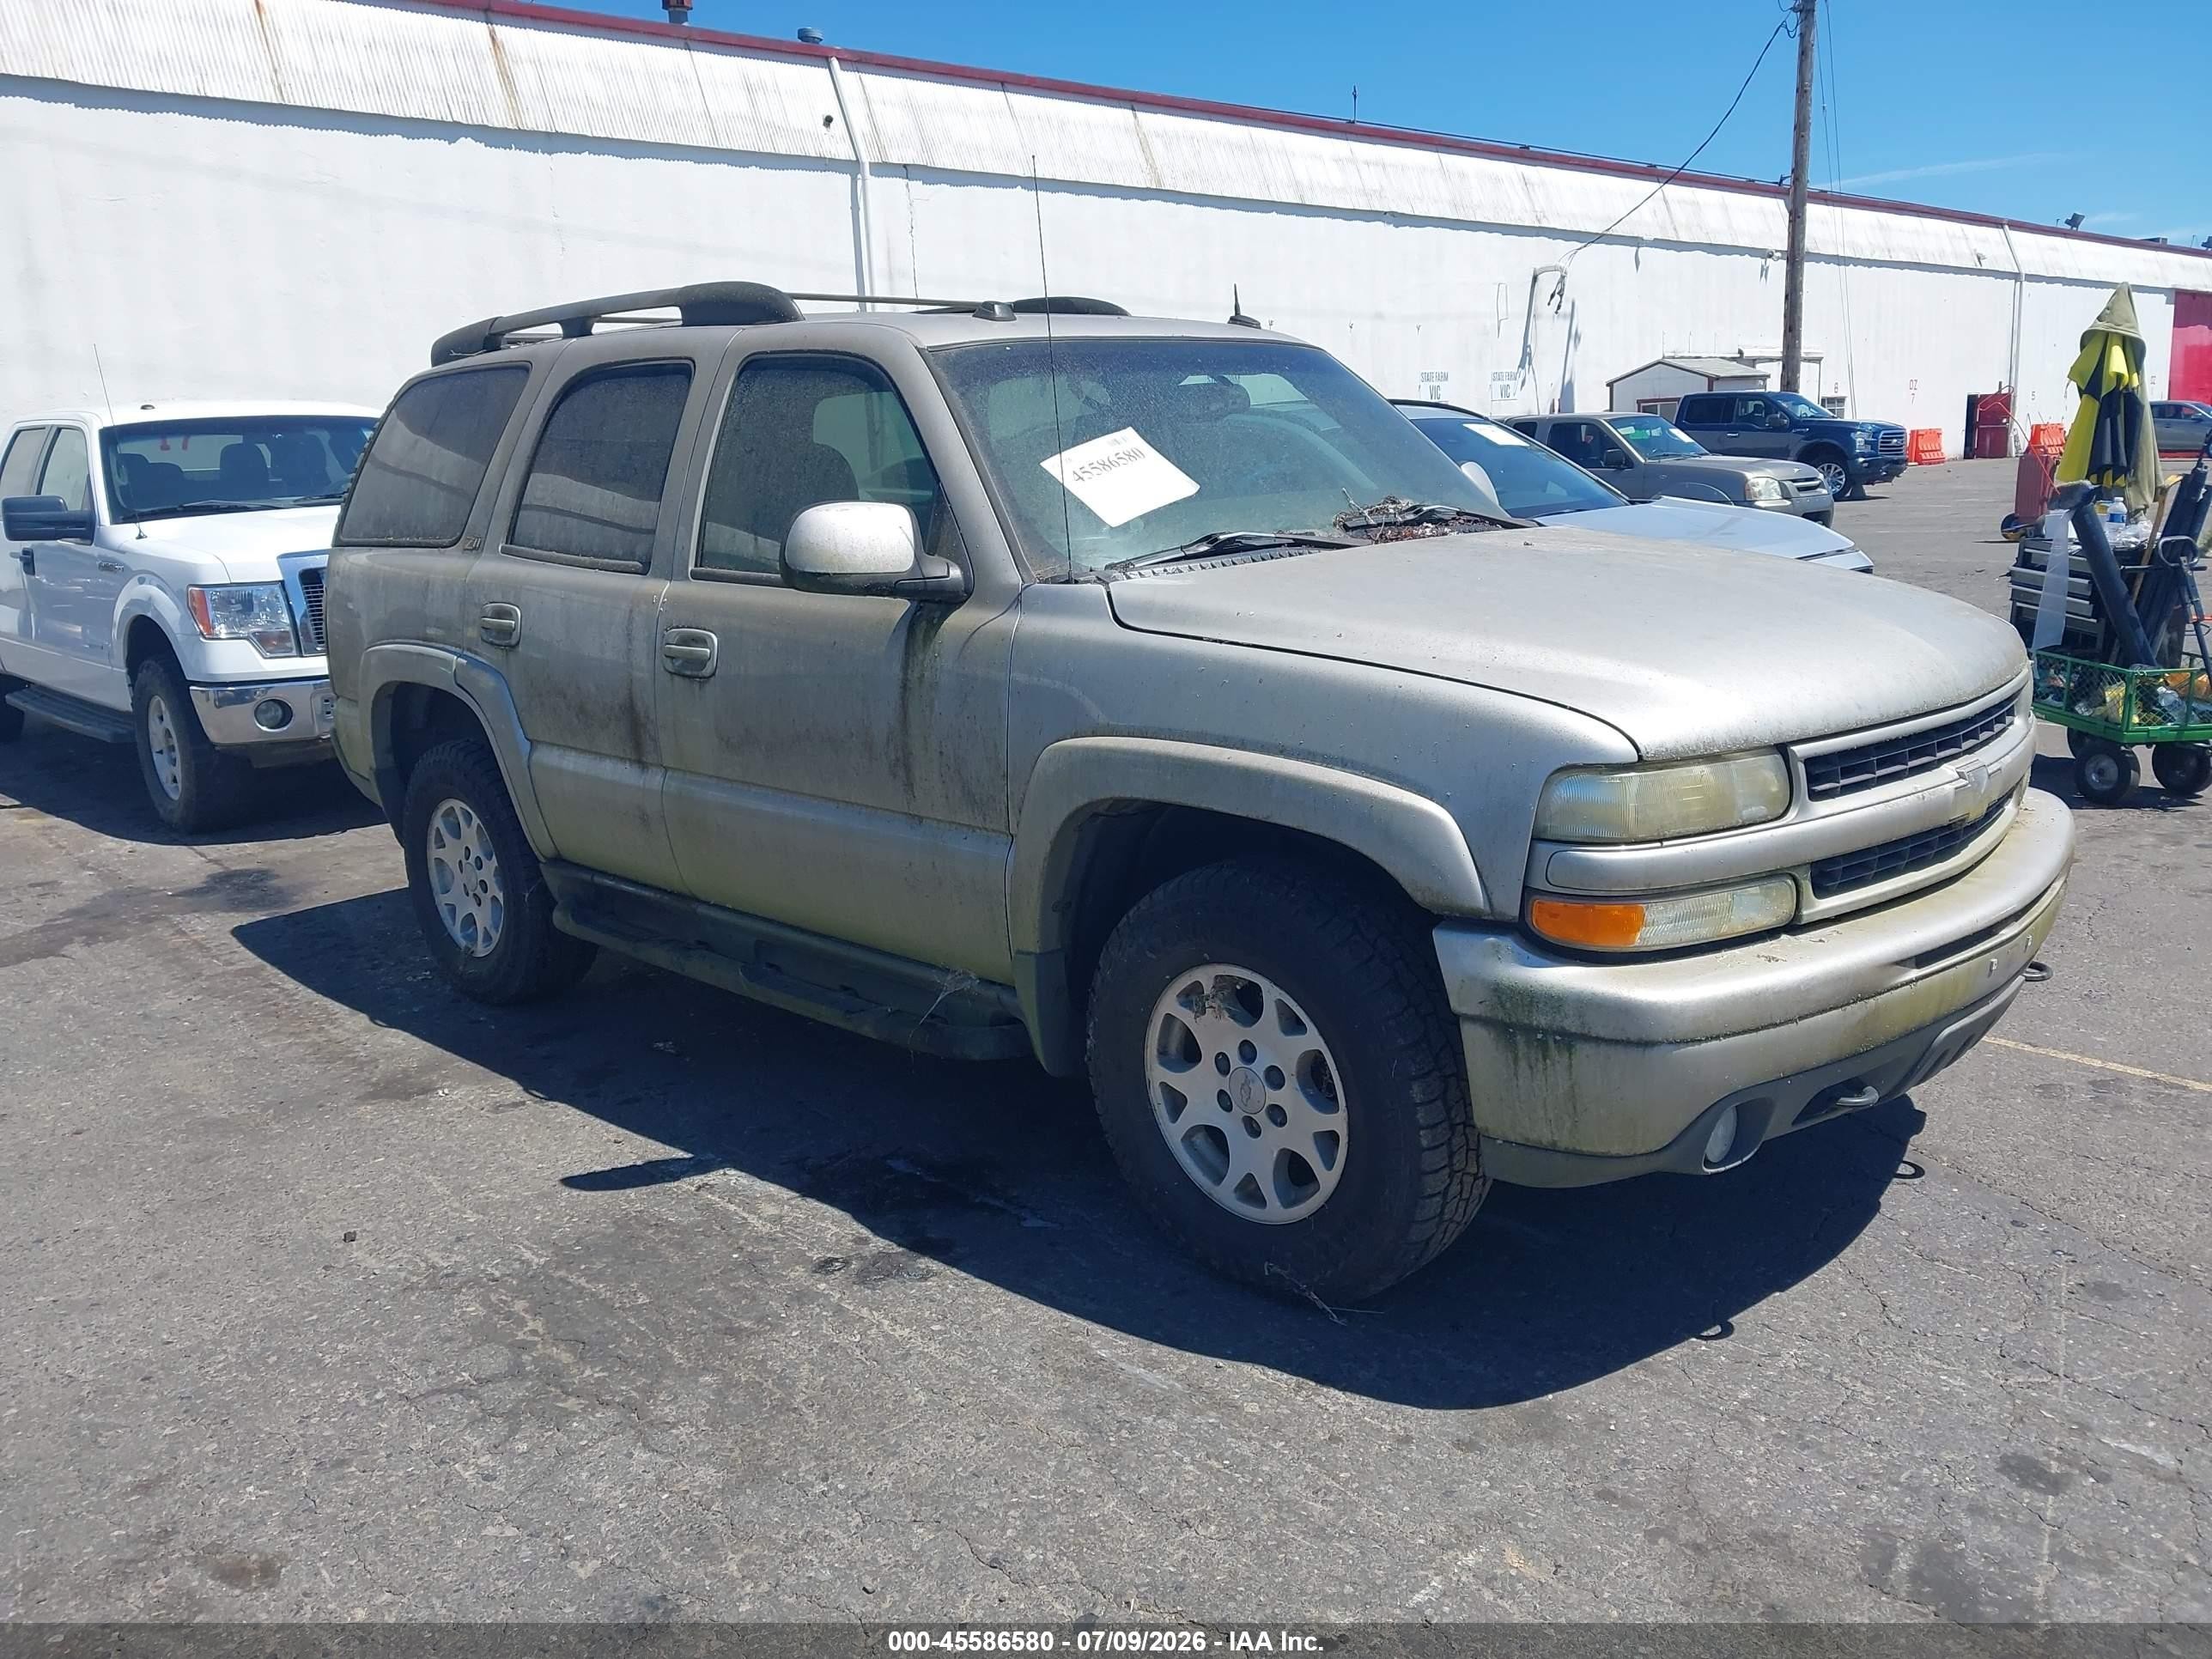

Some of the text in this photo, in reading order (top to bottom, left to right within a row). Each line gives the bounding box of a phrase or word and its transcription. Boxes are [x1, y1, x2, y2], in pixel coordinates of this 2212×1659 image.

[1420, 371, 1449, 383] STATE FARM
[1492, 371, 1517, 382] STATE FARM
[1429, 385, 1441, 400] VIC
[1499, 384, 1510, 398] VIC
[1073, 447, 1146, 482] 45586580
